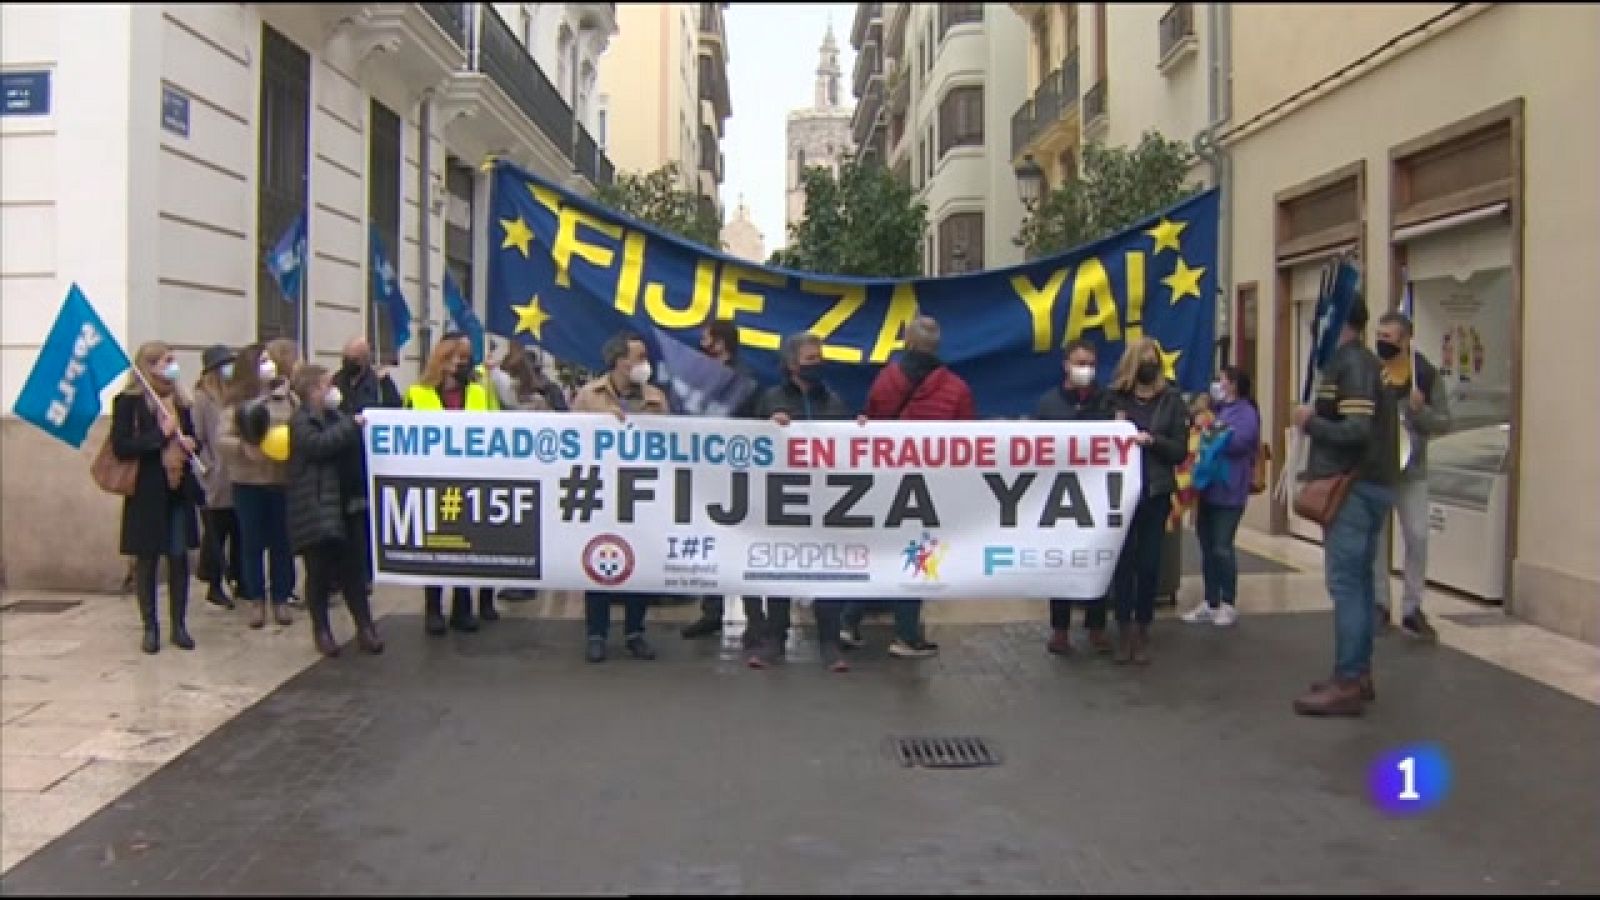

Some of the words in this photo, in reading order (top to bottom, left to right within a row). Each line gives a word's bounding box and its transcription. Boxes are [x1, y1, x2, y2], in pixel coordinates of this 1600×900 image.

[528, 183, 919, 362] FIJEZA
[1009, 251, 1146, 351] YA!
[371, 425, 580, 462] EMPLEAD@S
[594, 423, 773, 467] PÚBLIC@S
[787, 438, 835, 467] EN
[849, 437, 995, 467] FRAUDE
[1009, 437, 1056, 466] DE
[1067, 436, 1135, 466] LEY
[559, 465, 940, 528] #FIJEZA
[982, 472, 1123, 528] YA!
[667, 536, 715, 560] I#F
